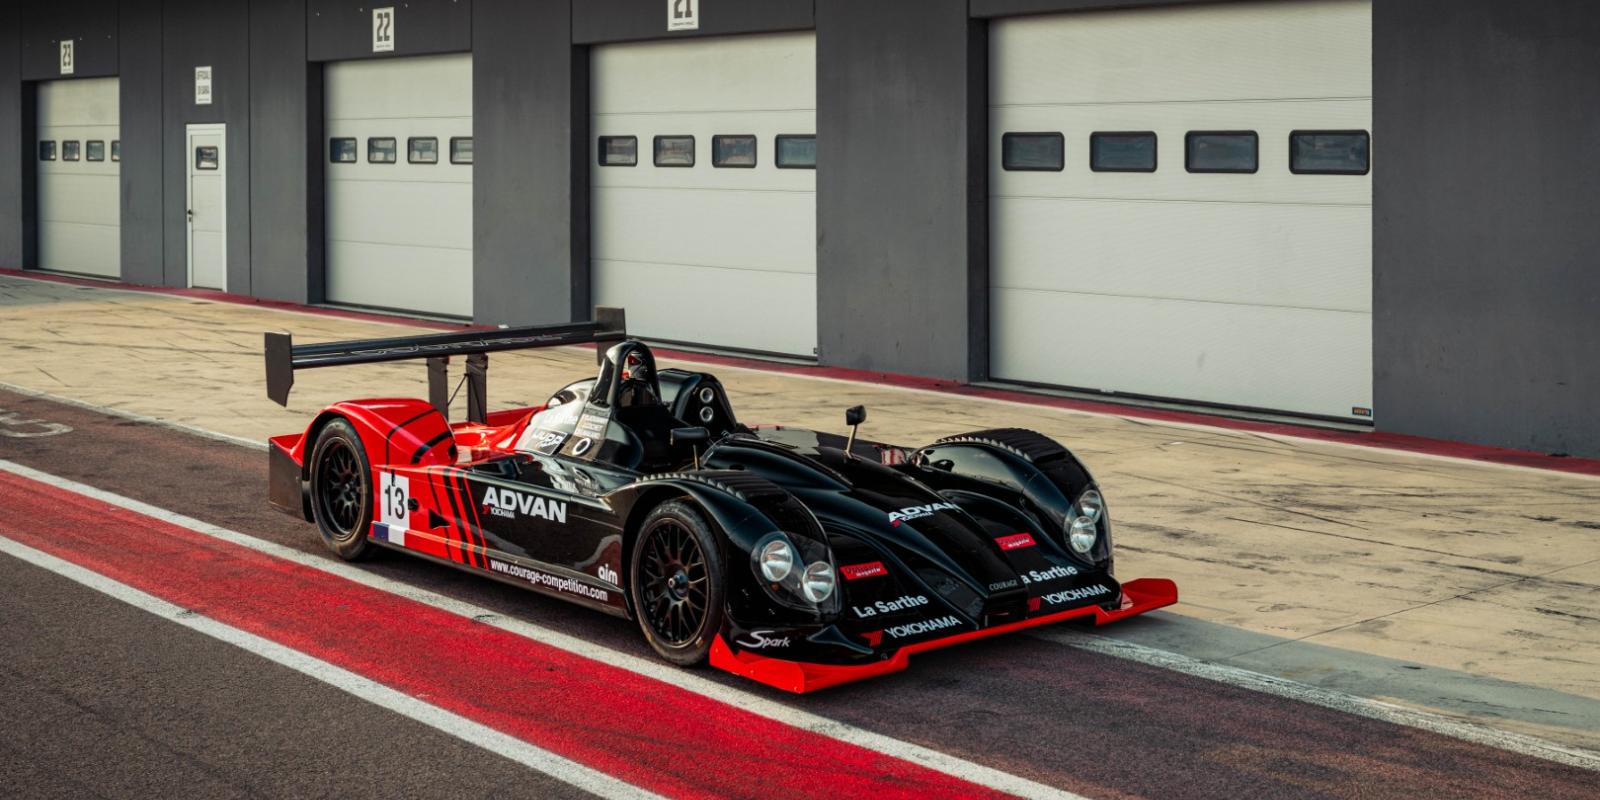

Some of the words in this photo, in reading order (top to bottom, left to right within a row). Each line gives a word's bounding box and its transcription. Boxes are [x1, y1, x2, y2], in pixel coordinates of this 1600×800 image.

[377, 12, 390, 42] 22
[63, 44, 71, 66] 23
[385, 485, 405, 519] 13
[482, 486, 567, 524] ADVAN
[888, 502, 961, 523] ADVAN
[490, 560, 608, 601] www.courage-competition.com
[598, 563, 618, 586] aim
[1029, 566, 1079, 582] Sarthe
[1041, 584, 1111, 605] YOKOHAMA
[852, 606, 877, 618] La
[875, 595, 929, 613] Sarthe
[884, 615, 963, 639] YOKOHAMA
[736, 630, 791, 649] Spark
